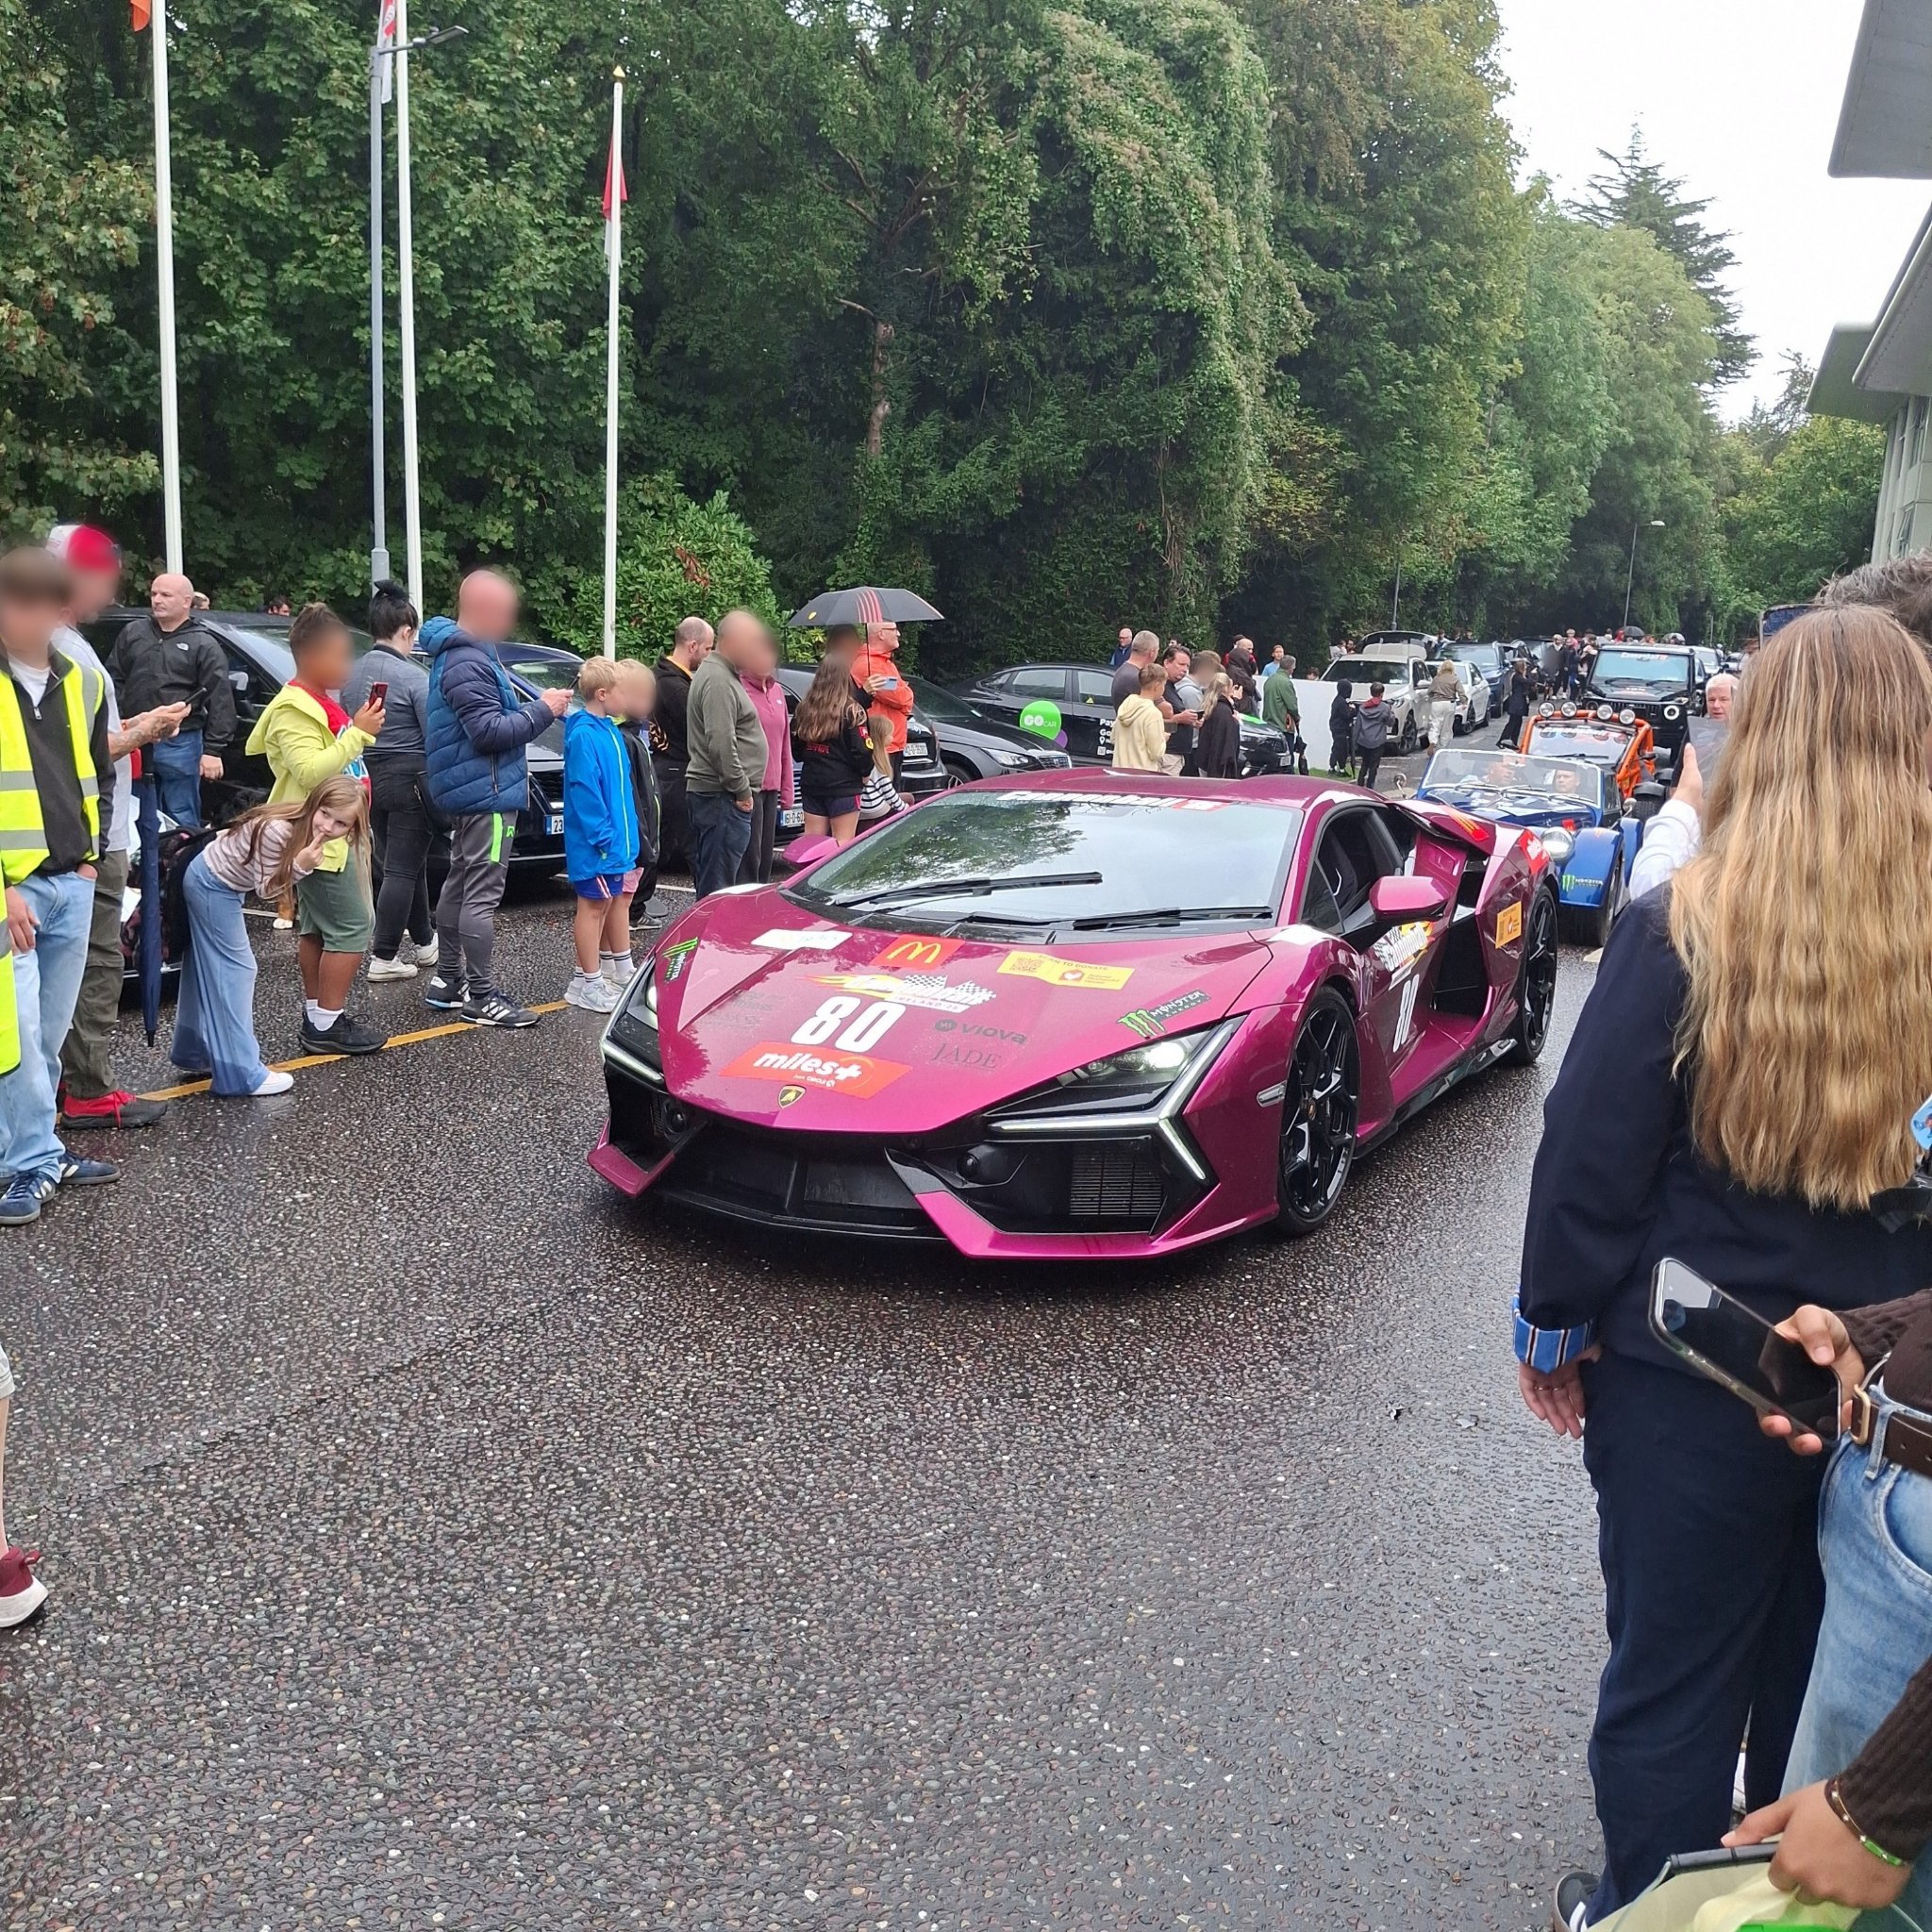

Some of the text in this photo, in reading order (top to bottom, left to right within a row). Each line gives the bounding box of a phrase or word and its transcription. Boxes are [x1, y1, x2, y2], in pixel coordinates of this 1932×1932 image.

[1150, 991, 1206, 1017] MONSTER
[791, 995, 907, 1053] 80
[753, 1052, 862, 1081] miles+
[931, 1043, 1002, 1068] JADE
